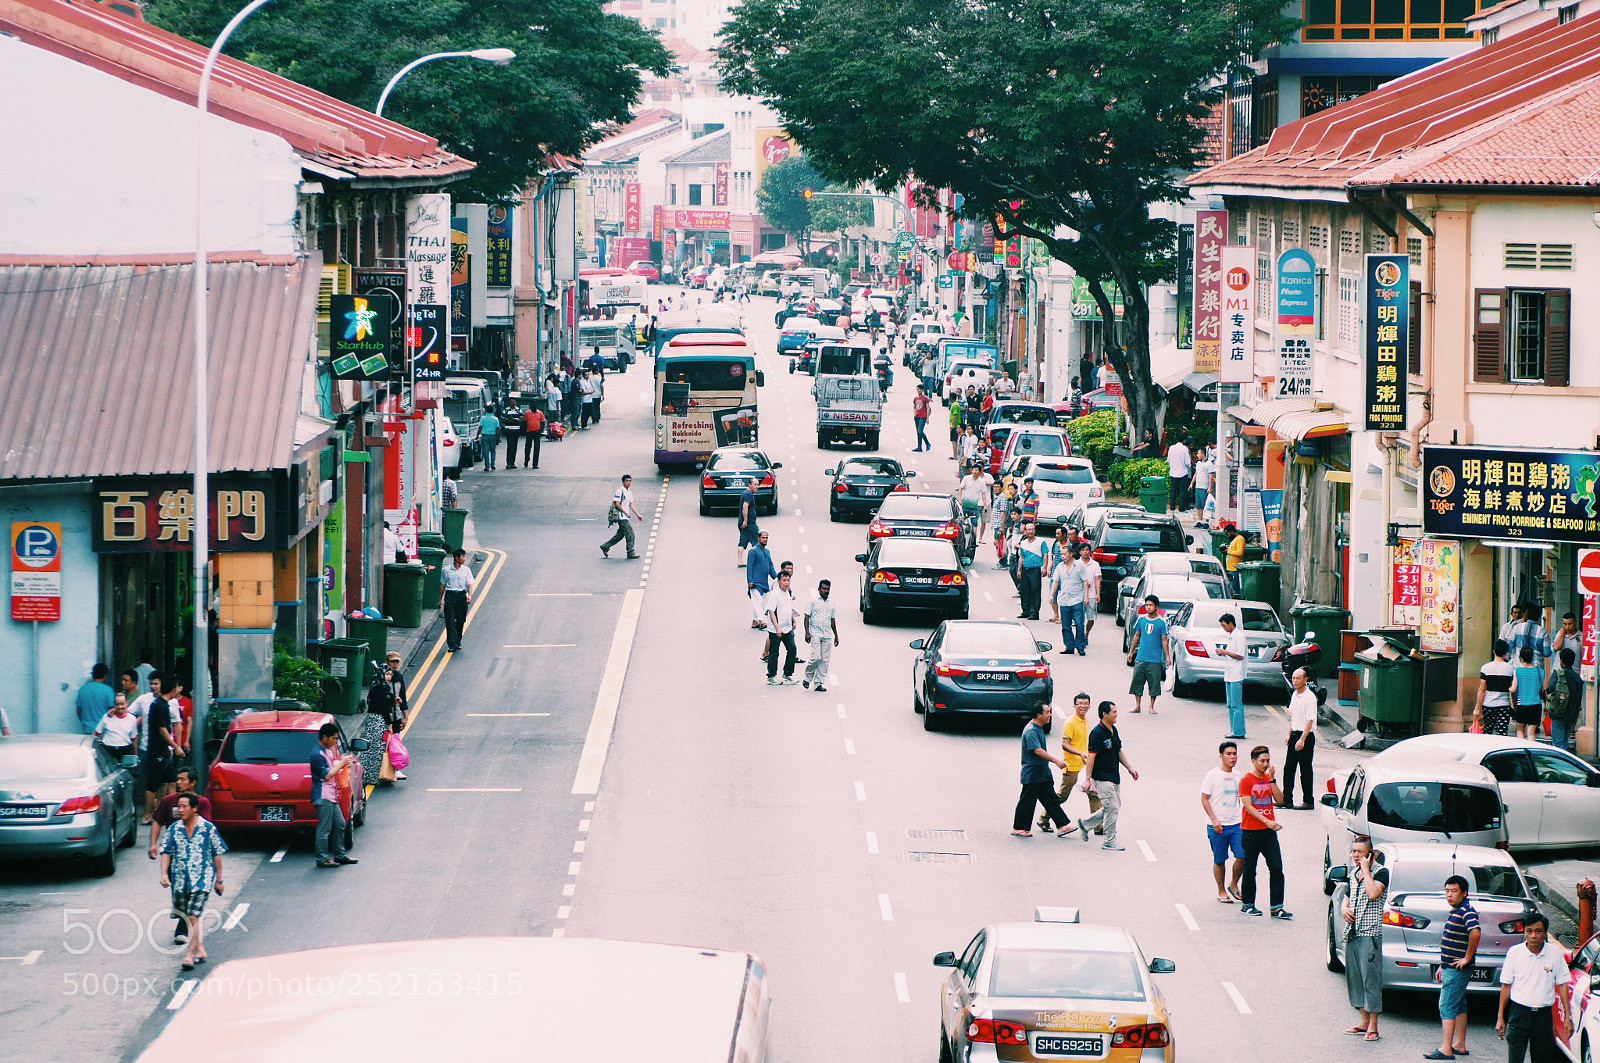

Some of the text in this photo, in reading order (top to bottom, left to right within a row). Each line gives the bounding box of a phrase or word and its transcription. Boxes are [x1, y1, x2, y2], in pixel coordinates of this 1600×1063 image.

[1326, 93, 1359, 107] 讲故
[408, 236, 447, 247] THAI
[408, 249, 447, 264] Massage
[360, 275, 404, 286] WANTED
[1280, 276, 1312, 285] Konica
[1280, 288, 1302, 296] Photo
[1375, 288, 1401, 302] Tiger
[1226, 298, 1249, 310] M1
[1280, 299, 1308, 307] Express
[407, 309, 437, 320] ingTel
[1073, 304, 1093, 316] 291
[1230, 313, 1245, 361] 专卖店
[336, 341, 385, 350] StarHub
[416, 368, 429, 378] 24
[1299, 387, 1310, 395] HR
[1372, 404, 1401, 412] EMINENT
[833, 412, 869, 420] NISSAN
[1369, 414, 1403, 422] FROG PORRIDGE
[672, 421, 714, 430] Refreshing
[1429, 499, 1455, 514] Tiger
[1462, 488, 1567, 514] 海鮮煮炒店
[1462, 512, 1491, 525] EMINENT
[1492, 514, 1510, 526] FROG
[1511, 515, 1545, 528] PORRIDGE
[1546, 519, 1551, 528] &
[1552, 518, 1583, 531] SEAFOOD
[1508, 527, 1522, 536] 323
[25, 529, 53, 556] P
[1035, 1011, 1056, 1021] The
[1069, 1013, 1102, 1023] Show
